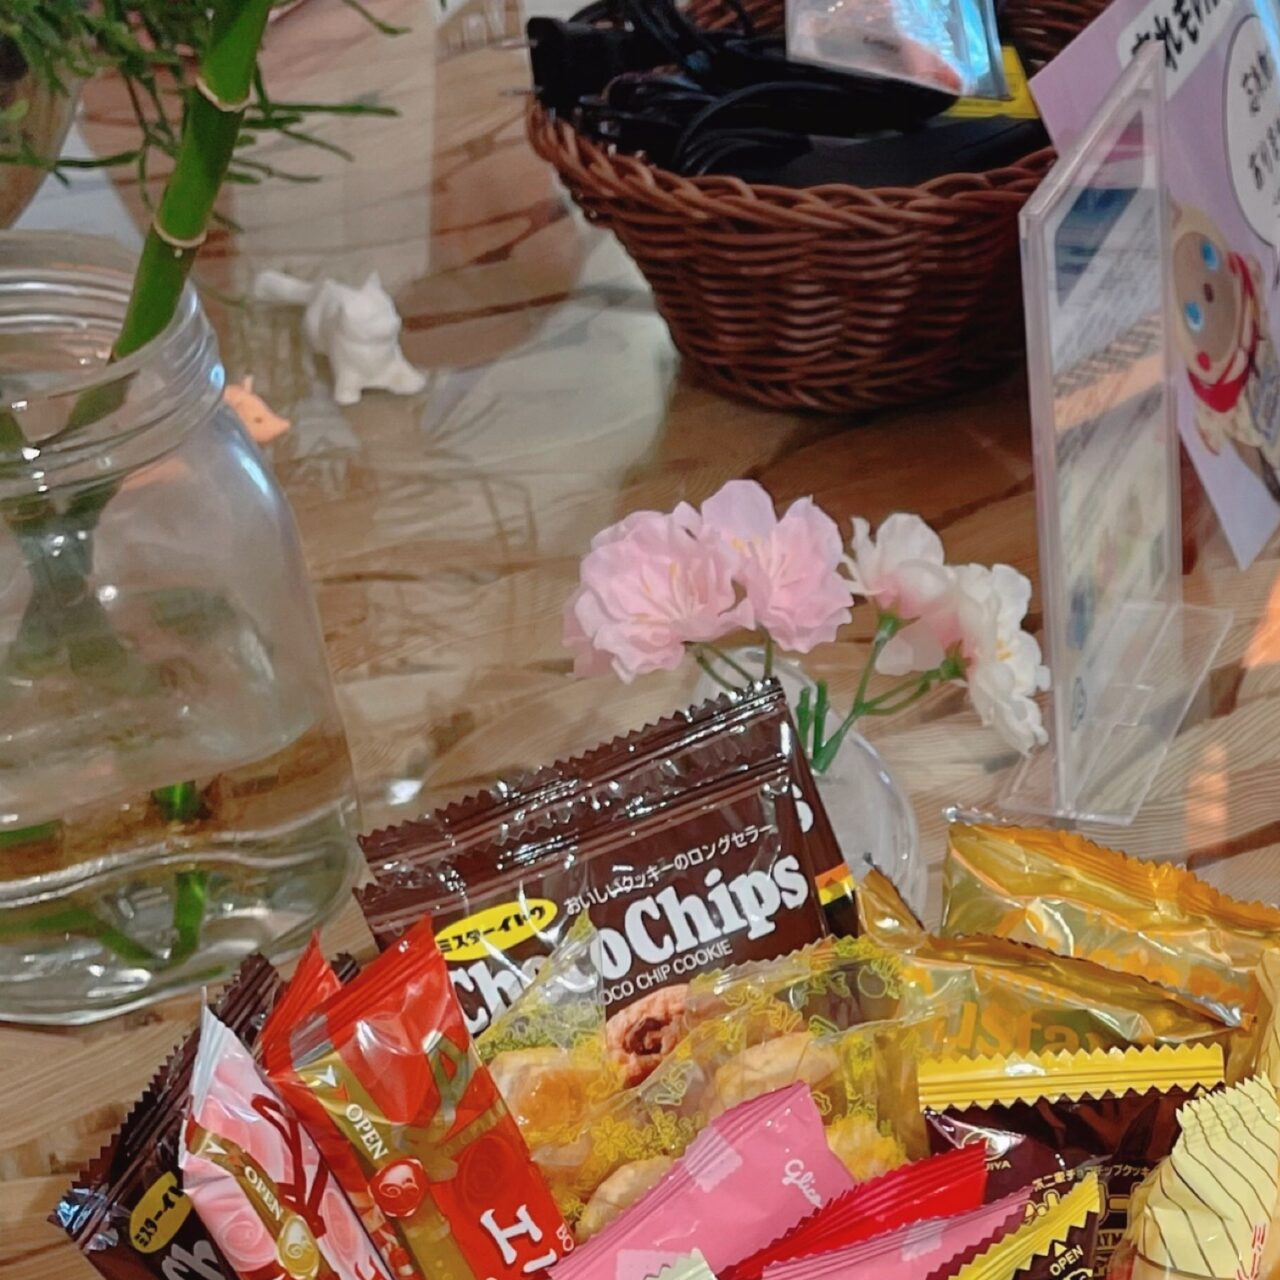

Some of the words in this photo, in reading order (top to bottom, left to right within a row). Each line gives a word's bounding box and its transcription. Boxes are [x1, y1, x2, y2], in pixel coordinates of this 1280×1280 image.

[564, 823, 774, 918] おいしいクッキーのロングセラー
[636, 966, 671, 997] CHIP
[672, 938, 733, 975] COOKIE
[345, 1103, 389, 1161] OPEN
[244, 1164, 283, 1221] OPEN
[1050, 1245, 1084, 1278] OPEN
